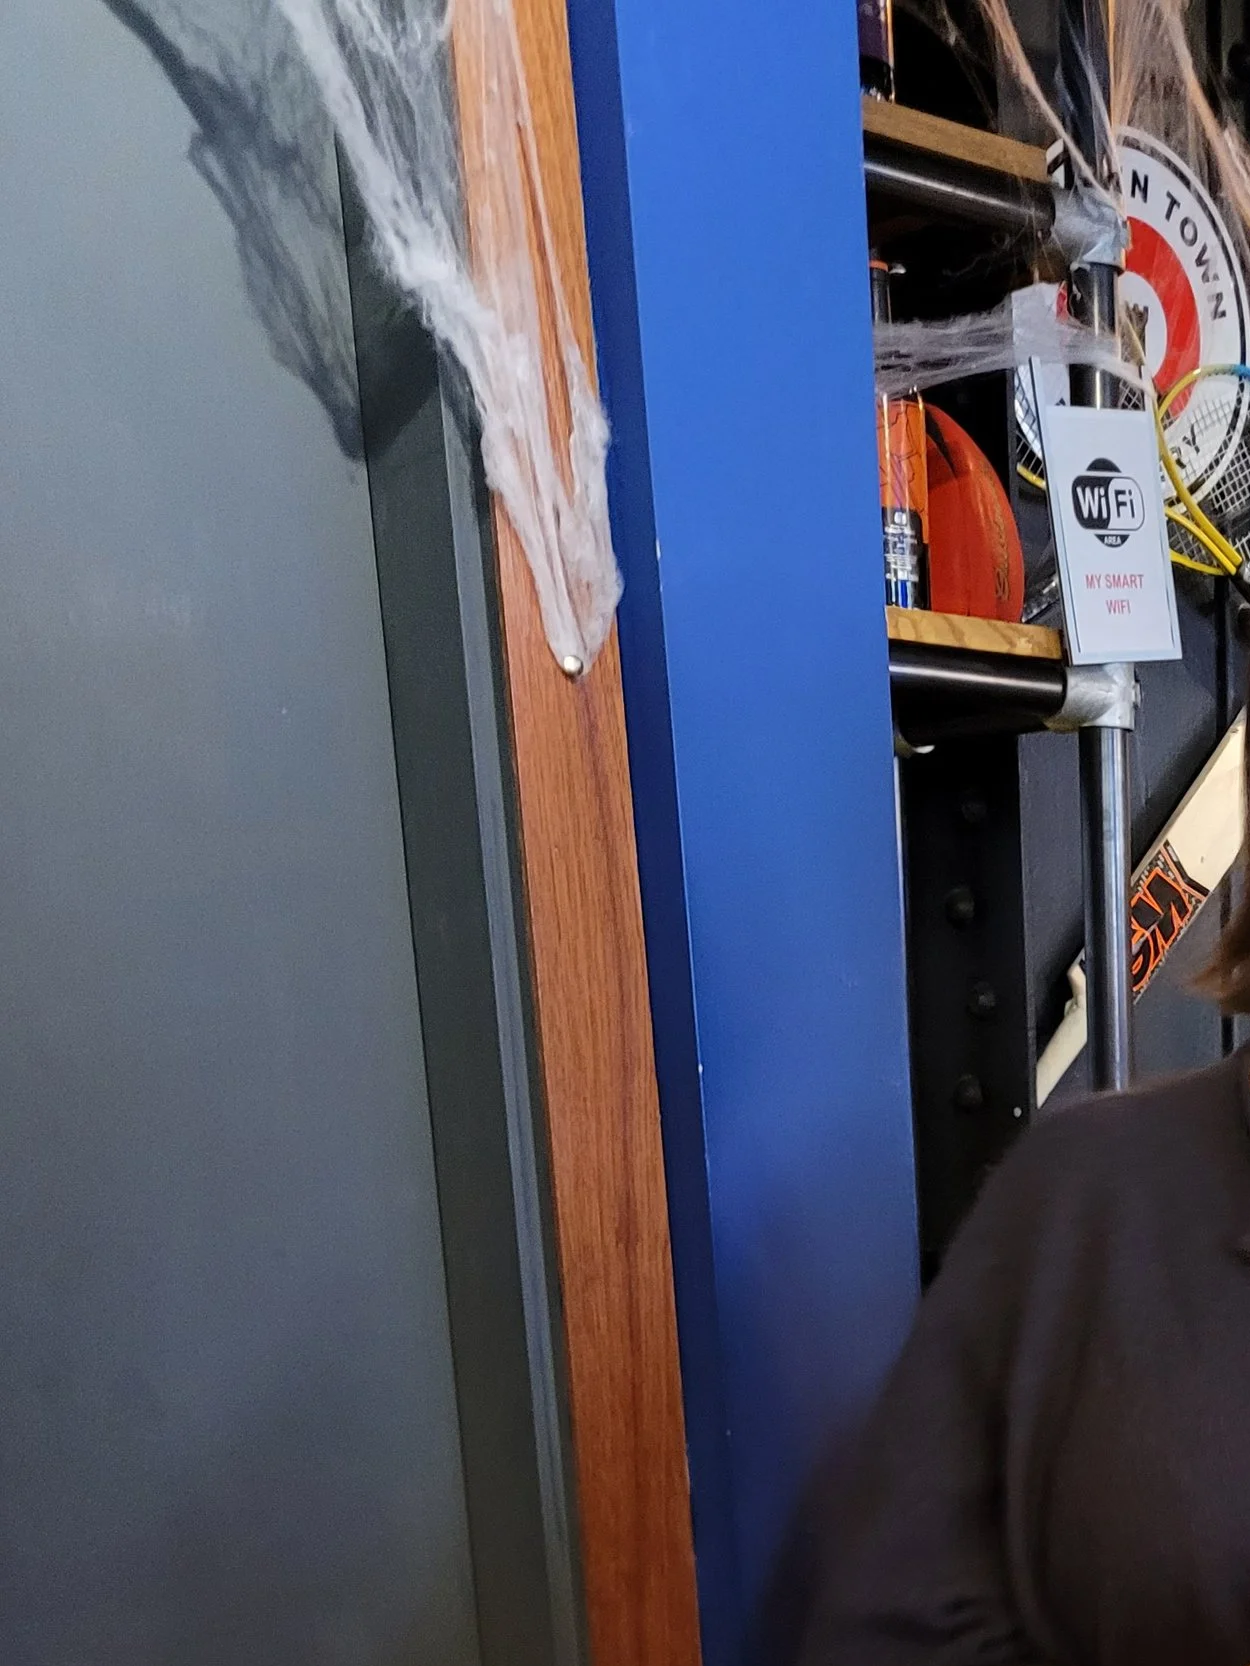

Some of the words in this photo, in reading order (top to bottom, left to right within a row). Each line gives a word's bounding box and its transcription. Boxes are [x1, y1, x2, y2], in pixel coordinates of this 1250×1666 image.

[1163, 190, 1227, 322] TOWN
[1104, 535, 1122, 546] AREA
[1086, 574, 1101, 589] MY
[1105, 574, 1144, 589] SMART
[1106, 599, 1131, 615] WIFI
